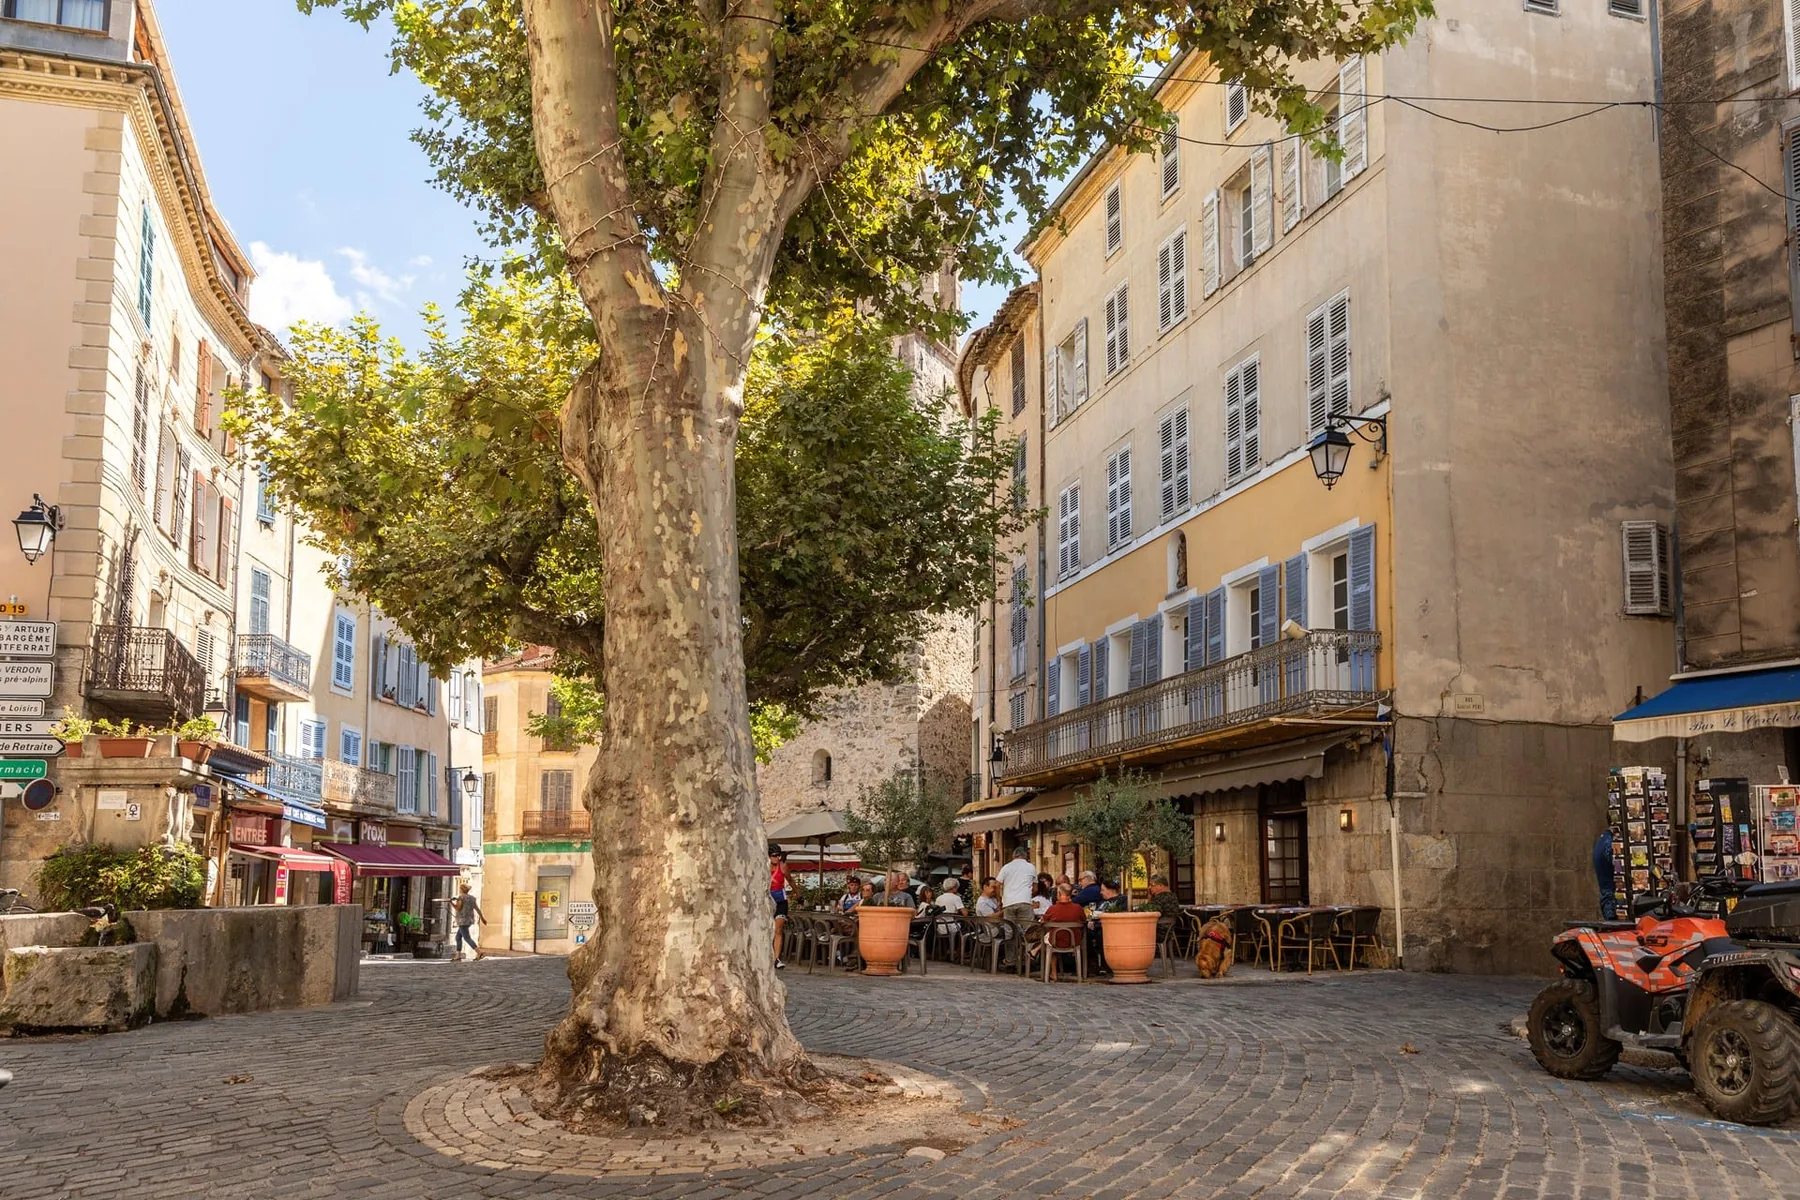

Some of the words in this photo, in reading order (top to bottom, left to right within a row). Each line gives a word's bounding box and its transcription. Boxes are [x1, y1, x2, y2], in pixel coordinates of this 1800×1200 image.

[12, 604, 25, 613] 19
[14, 625, 51, 634] ARTUBY
[5, 666, 42, 674] VERDON
[4, 675, 49, 684] pré-alpins
[9, 704, 38, 712] Loisirs
[12, 742, 53, 751] Retraite
[235, 825, 267, 845] ENTRÉE
